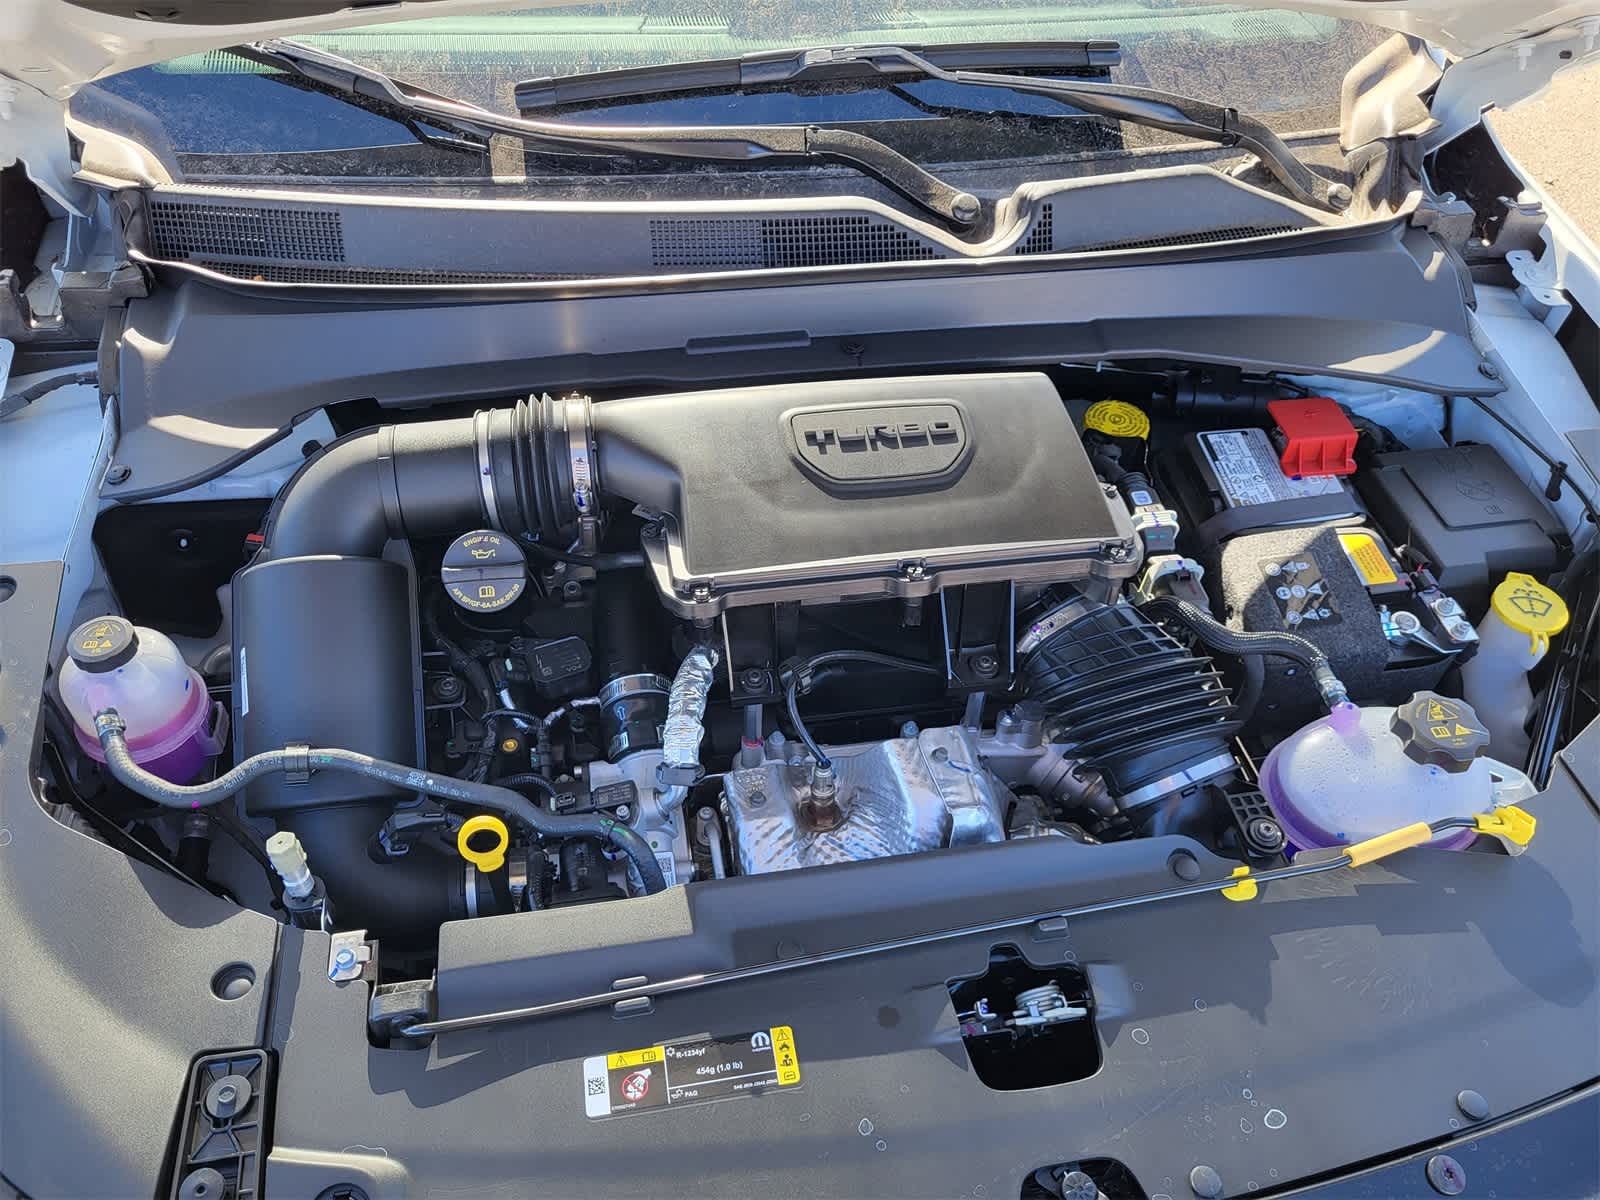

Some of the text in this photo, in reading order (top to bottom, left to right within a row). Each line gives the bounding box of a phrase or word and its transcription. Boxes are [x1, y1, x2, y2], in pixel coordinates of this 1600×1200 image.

[803, 420, 959, 455] TURBO
[489, 535, 502, 545] OIL
[676, 1047, 706, 1059] R-1234yf
[695, 1060, 744, 1075] 454g (1.0 lb)
